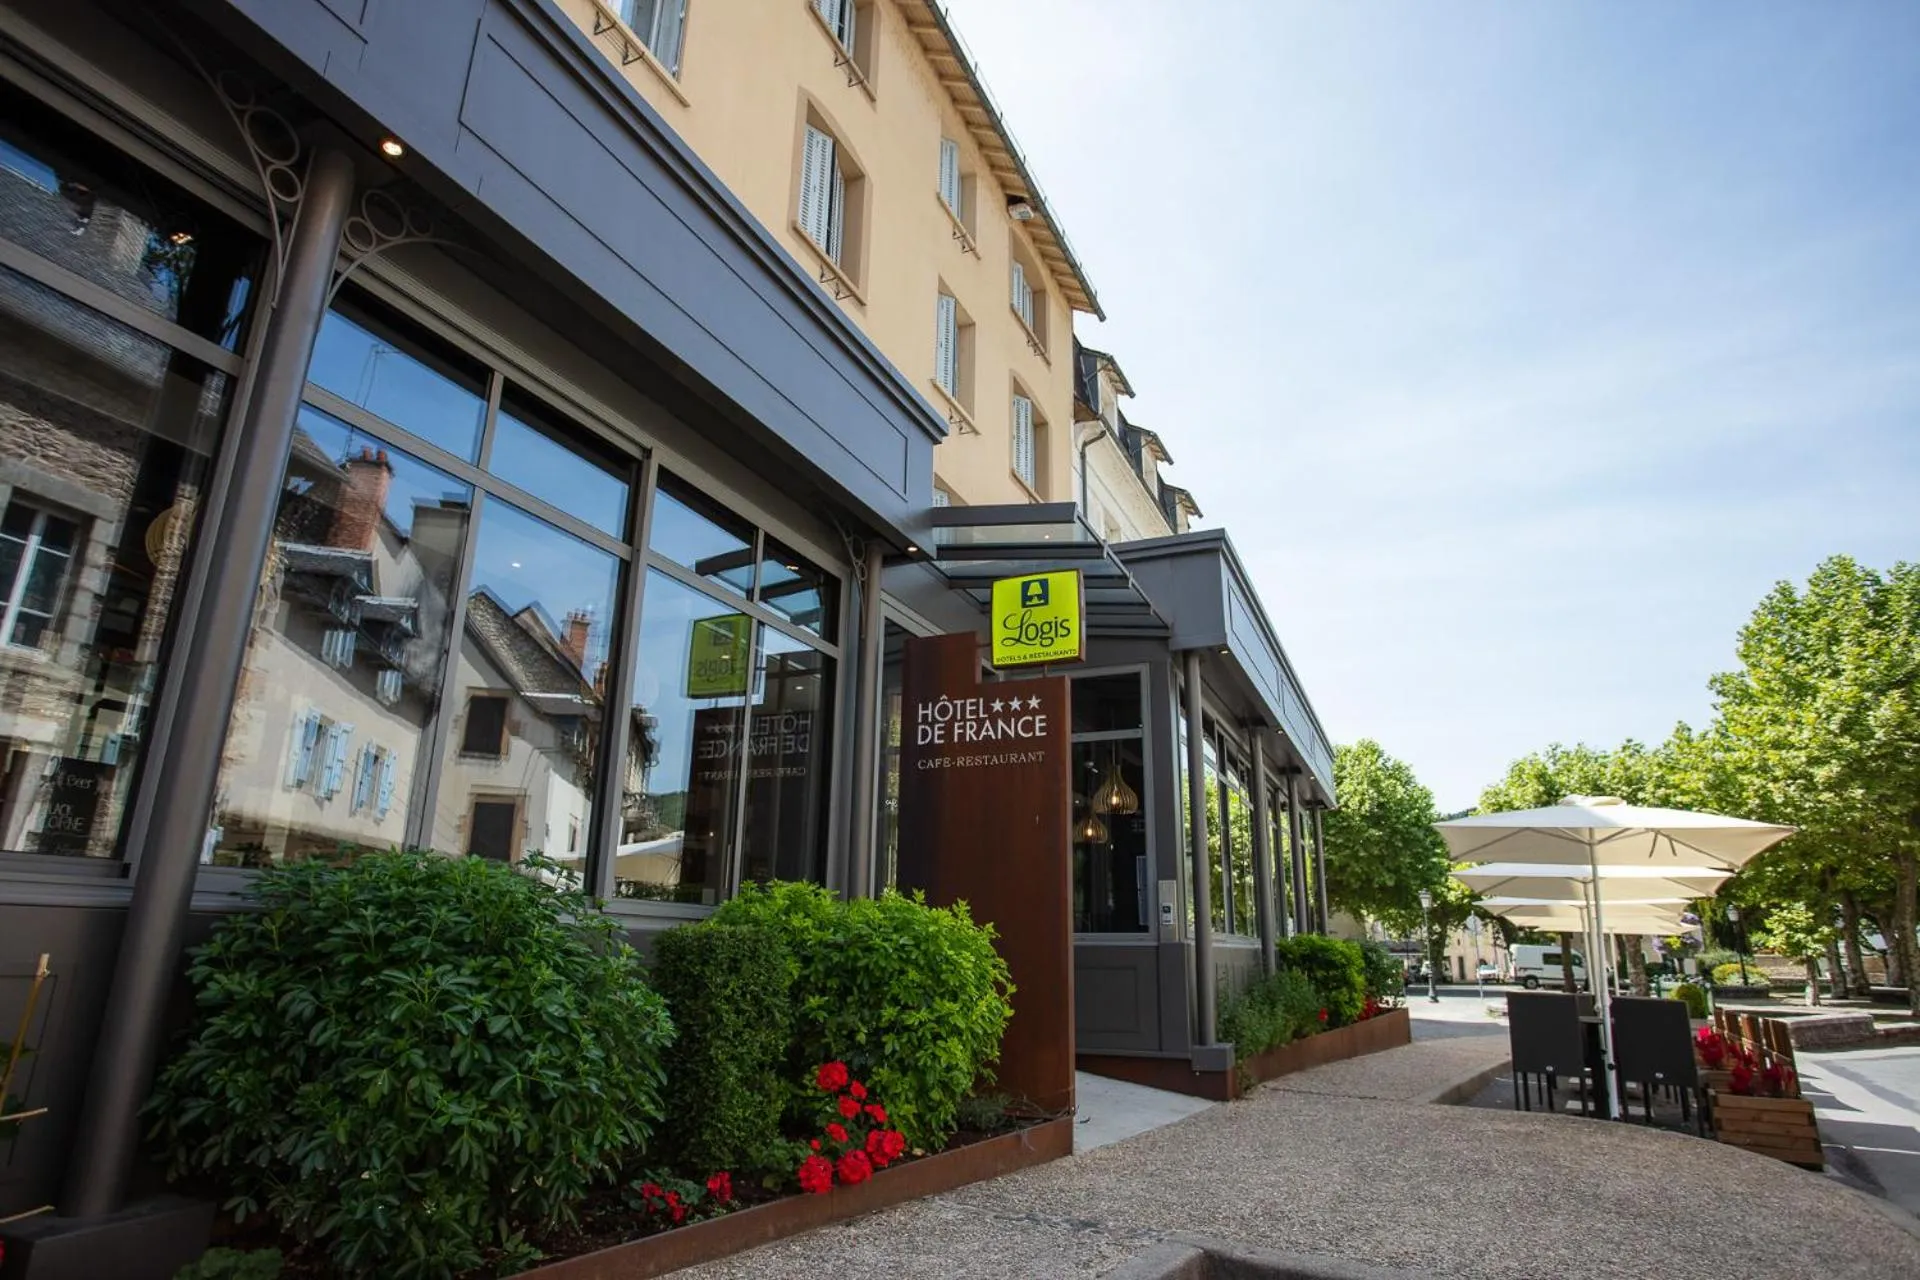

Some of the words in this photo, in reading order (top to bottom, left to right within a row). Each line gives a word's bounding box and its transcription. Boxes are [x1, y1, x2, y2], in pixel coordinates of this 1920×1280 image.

[1001, 609, 1070, 647] Logis
[1028, 648, 1077, 660] RESTAURANTS
[918, 694, 988, 723] HÔTEL
[916, 723, 945, 746] DE
[954, 715, 1047, 743] FRANCE
